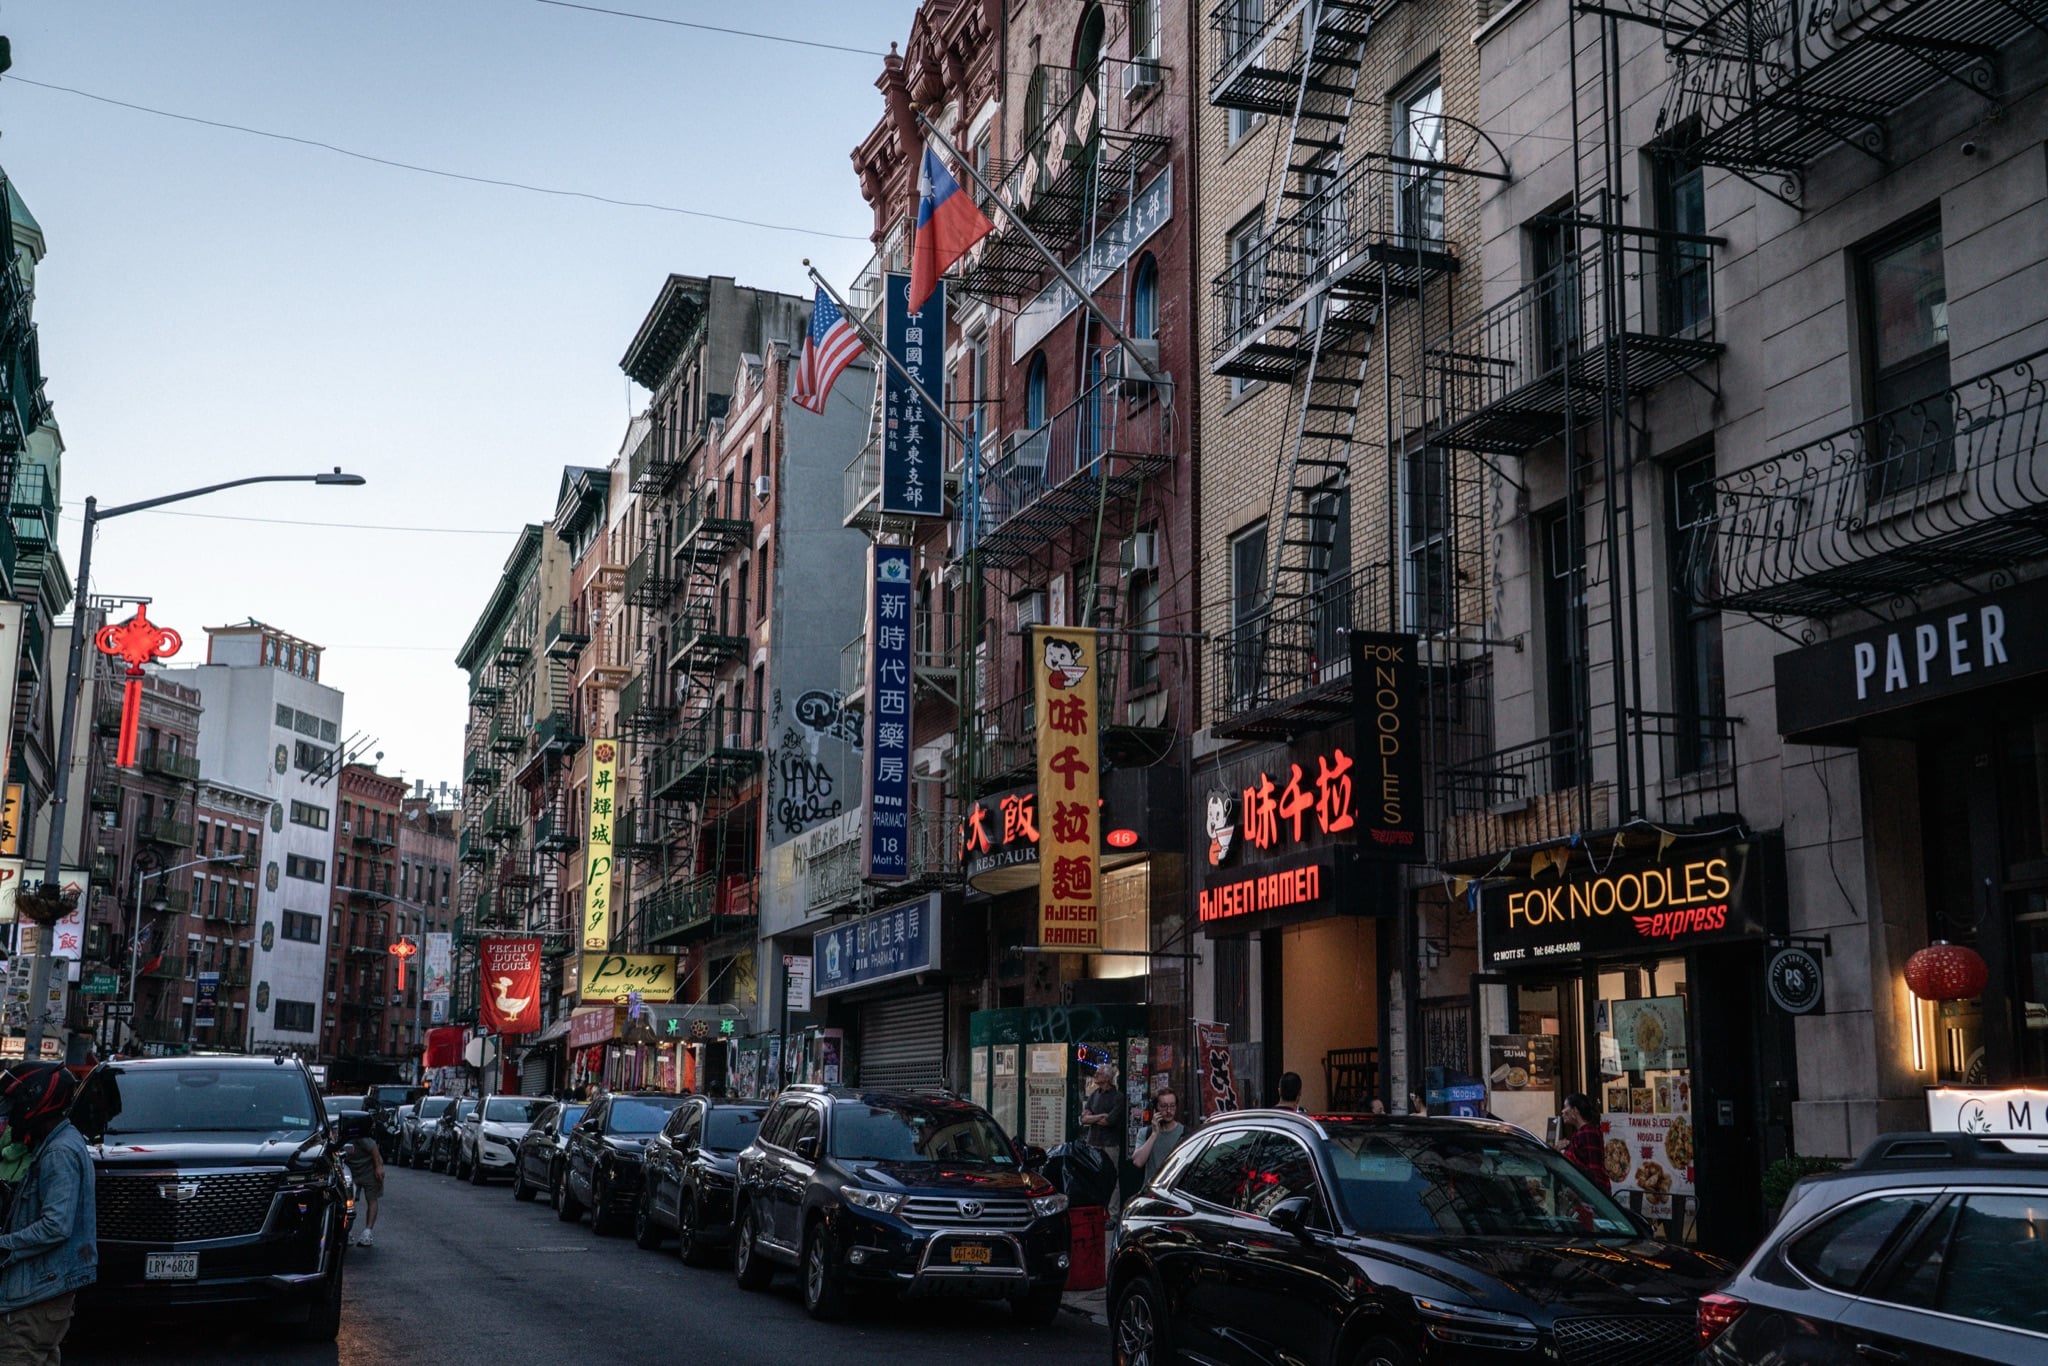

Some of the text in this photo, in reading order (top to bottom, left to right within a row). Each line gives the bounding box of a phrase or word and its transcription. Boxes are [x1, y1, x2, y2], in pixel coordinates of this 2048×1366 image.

[1363, 644, 1405, 663] FOK
[1854, 604, 2009, 701] PAPER
[877, 592, 906, 784] 新時代西藥房
[1376, 666, 1402, 825] NOODLES
[874, 794, 903, 806] DIN
[1242, 748, 1355, 850] 味千拉
[872, 811, 908, 829] PHARMACY
[966, 793, 1041, 854] 大飯
[881, 837, 898, 854] 18
[1113, 832, 1131, 844] 16
[872, 854, 907, 867] Mott St.
[976, 847, 1039, 872] RESTAUR
[588, 855, 611, 931] Ping
[1199, 864, 1320, 922] AJISEN RAMEN
[1507, 857, 1731, 929] FOK NOODLES
[1045, 904, 1098, 922] AJISEN
[1650, 904, 1728, 941] express
[845, 906, 920, 958] 新時代西藥房
[1044, 927, 1098, 945] RAMEN
[487, 943, 536, 954] PEKING
[586, 937, 605, 948] 22
[493, 952, 529, 962] DUCK
[1493, 951, 1501, 961] 12
[1501, 948, 1516, 960] MOTT
[490, 961, 532, 972] HOUSE
[591, 955, 667, 985] Ping
[1784, 968, 1802, 987] PS
[583, 981, 673, 994] Seafood Restaurant
[618, 996, 630, 1004] 2
[1596, 1003, 1607, 1024] A
[667, 1018, 734, 1035] 昇 輝
[1628, 1117, 1651, 1128] TAIWAN
[1637, 1133, 1663, 1143] NOODLES
